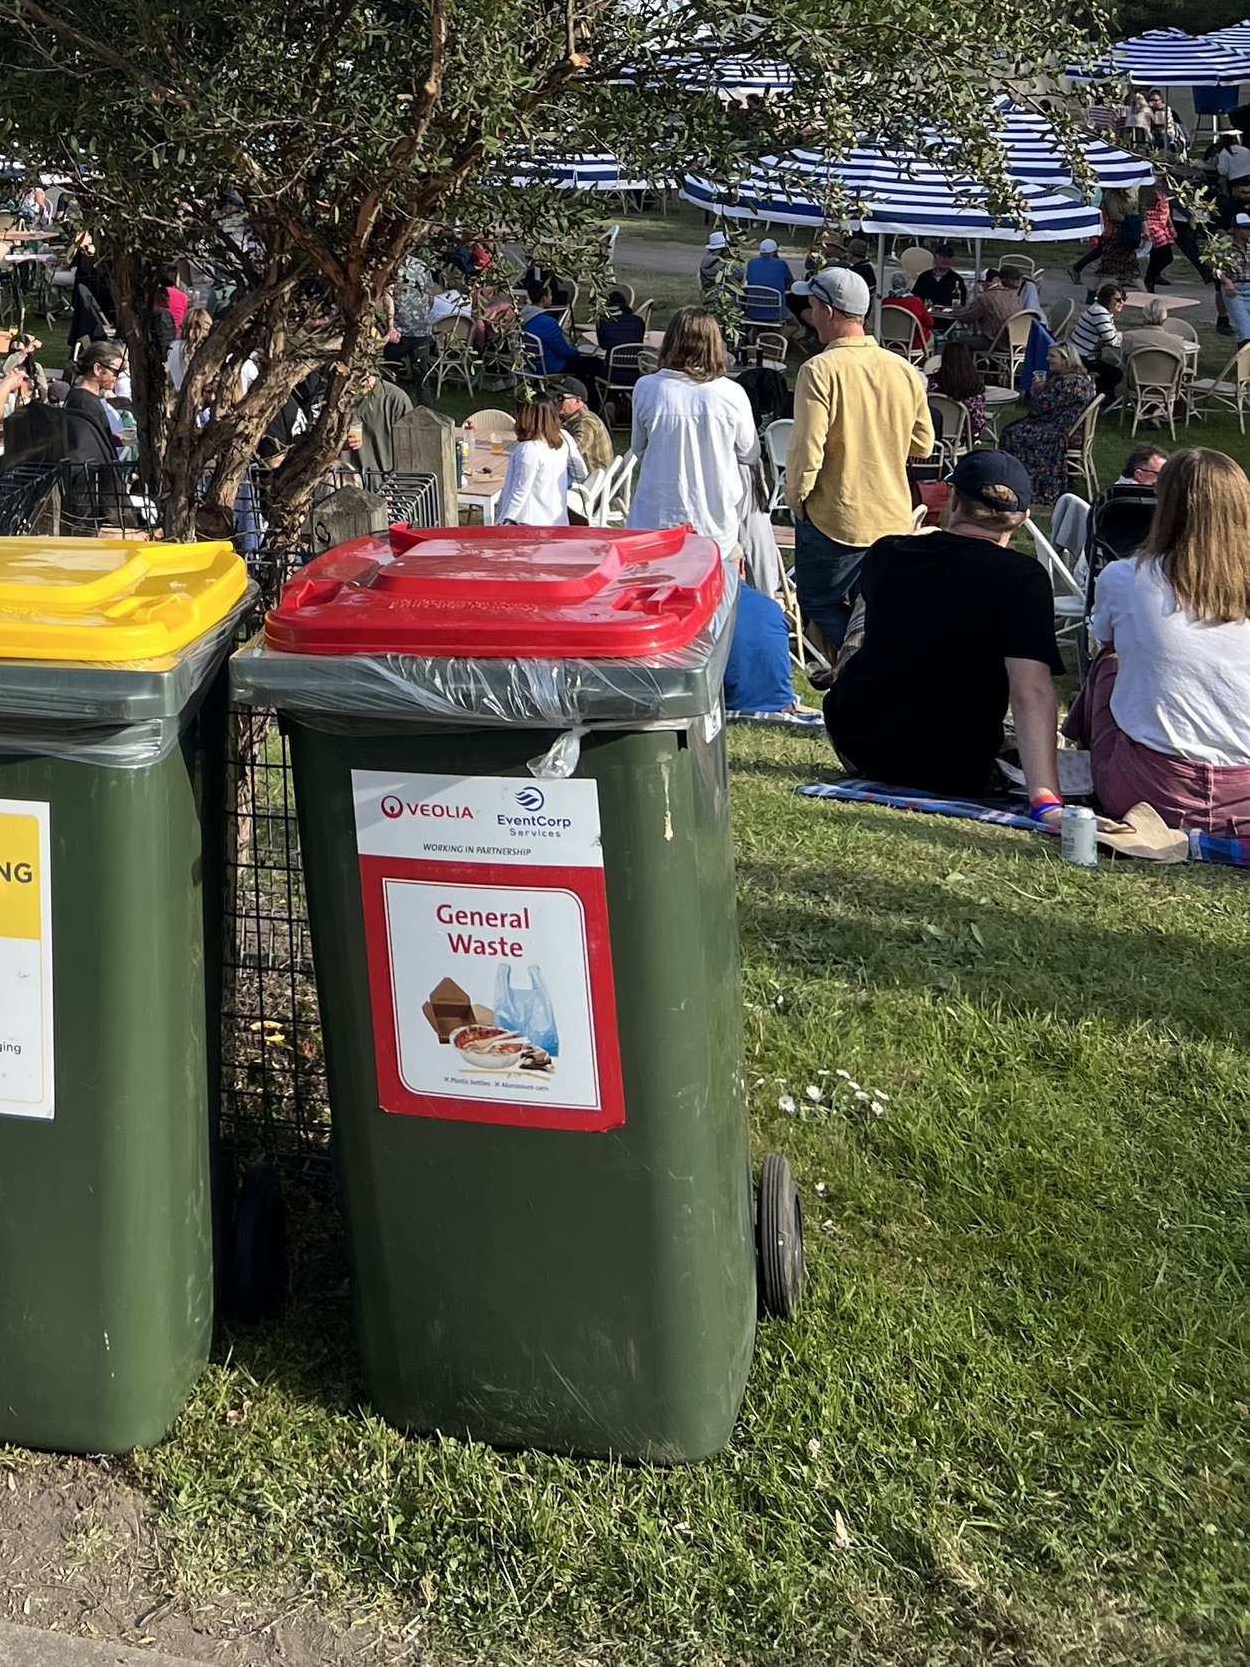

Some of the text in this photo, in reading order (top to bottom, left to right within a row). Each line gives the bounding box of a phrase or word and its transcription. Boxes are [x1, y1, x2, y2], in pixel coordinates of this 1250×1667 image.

[406, 803, 474, 819] VEOLIA
[497, 814, 571, 829] EventCorp
[509, 828, 561, 838] Services
[423, 843, 532, 856] WORKING IN PARTNERSHIP
[436, 903, 530, 929] General
[447, 932, 523, 957] Waste
[470, 1079, 490, 1087] bottles
